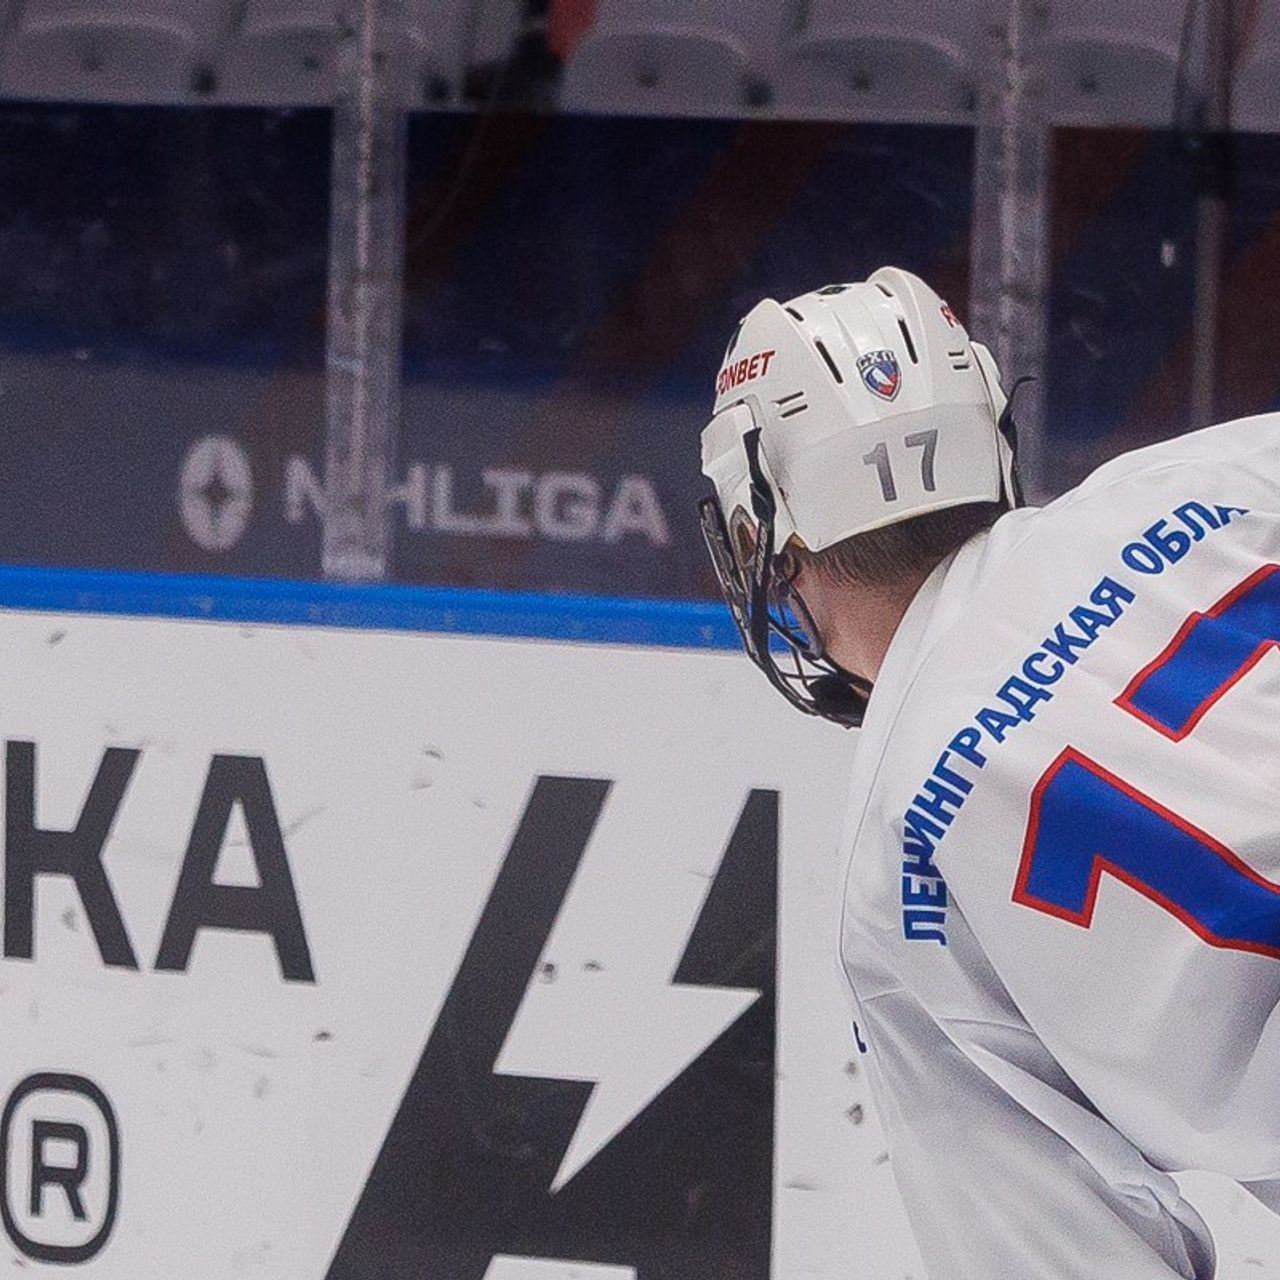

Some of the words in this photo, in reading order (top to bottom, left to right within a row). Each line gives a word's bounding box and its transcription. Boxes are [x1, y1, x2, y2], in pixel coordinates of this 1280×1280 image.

[285, 455, 672, 548] NHLIGA
[863, 428, 938, 502] 17
[902, 576, 1136, 945] ЛЕНИНГРАДСКАЯ
[4, 740, 316, 983] КА
